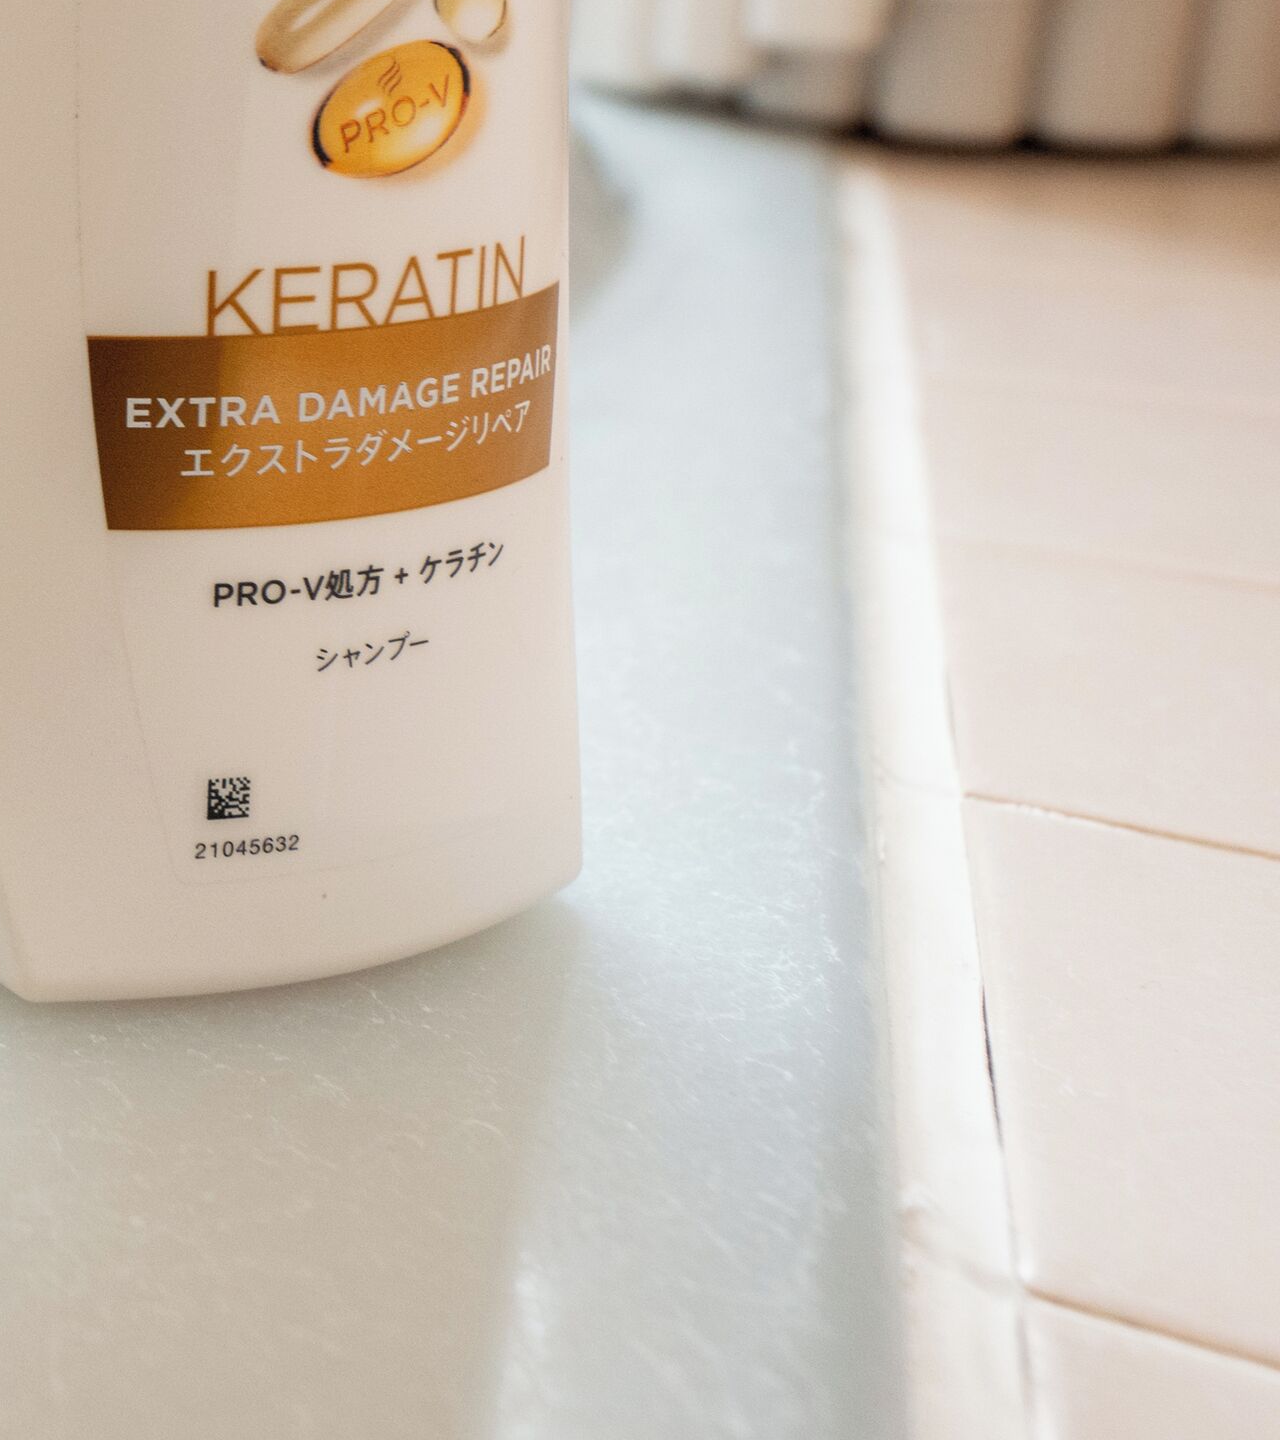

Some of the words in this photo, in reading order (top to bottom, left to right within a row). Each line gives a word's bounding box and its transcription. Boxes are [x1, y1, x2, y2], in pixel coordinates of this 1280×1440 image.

[340, 75, 453, 153] PRO-V
[206, 235, 526, 336] KERATIN
[125, 394, 281, 429] EXTRA
[298, 373, 461, 423] DAMAGE
[470, 344, 553, 398] REPAIR
[180, 400, 532, 478] エクストラダメージリペア
[212, 565, 385, 608] PRO-V処方
[418, 540, 505, 585] ケラチン
[316, 631, 430, 672] シャンプー
[194, 834, 300, 860] 21045632
